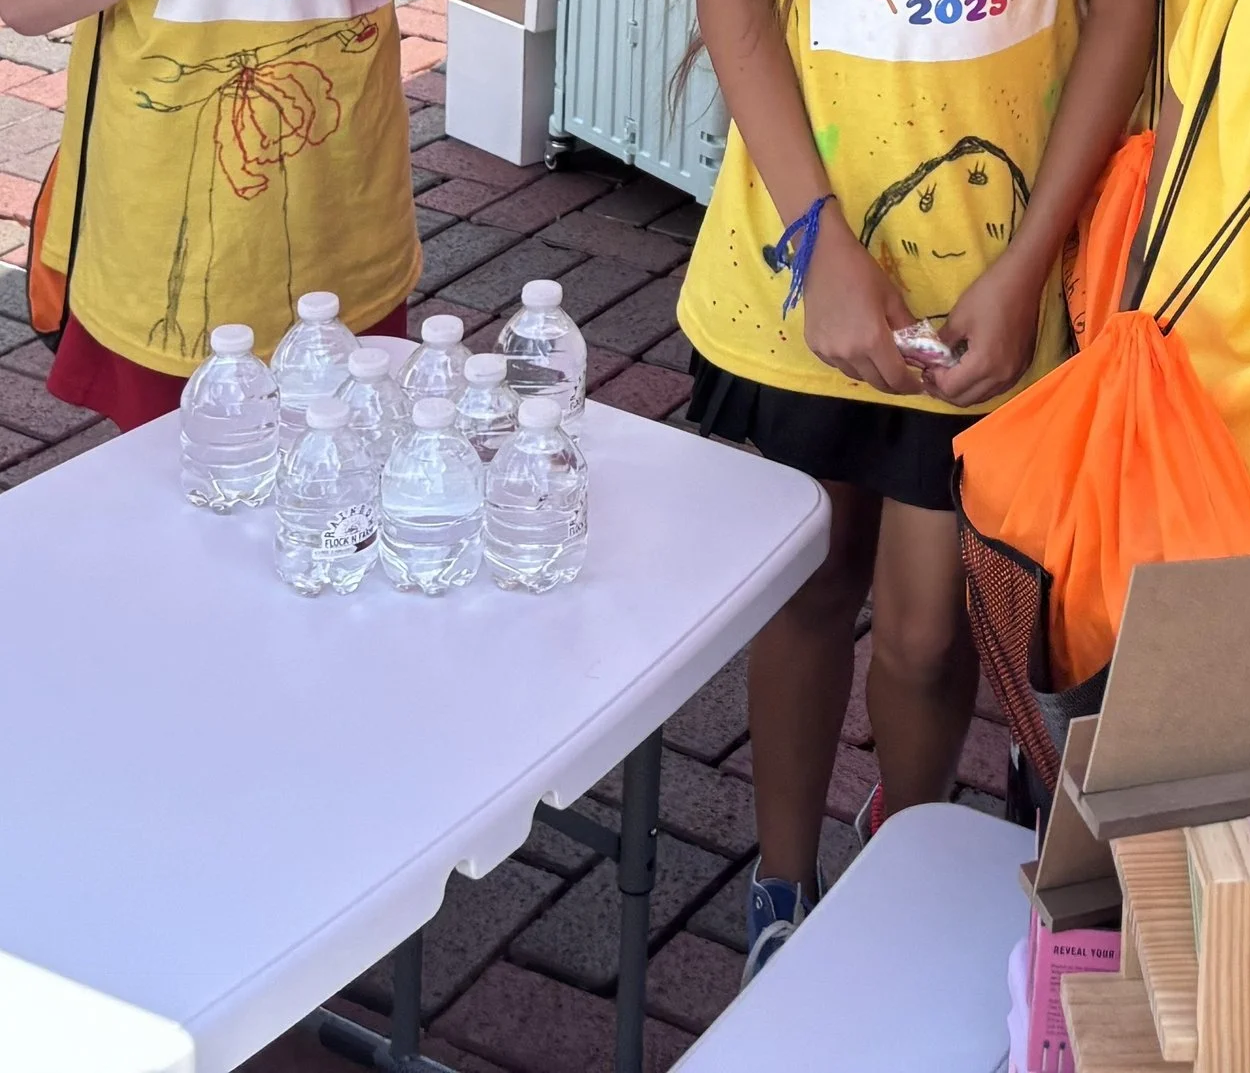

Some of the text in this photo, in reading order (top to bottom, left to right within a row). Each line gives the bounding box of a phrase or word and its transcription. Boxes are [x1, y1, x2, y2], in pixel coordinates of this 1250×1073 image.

[325, 536, 350, 549] FLOCK
[1053, 945, 1115, 960] REVEAL YOUR
